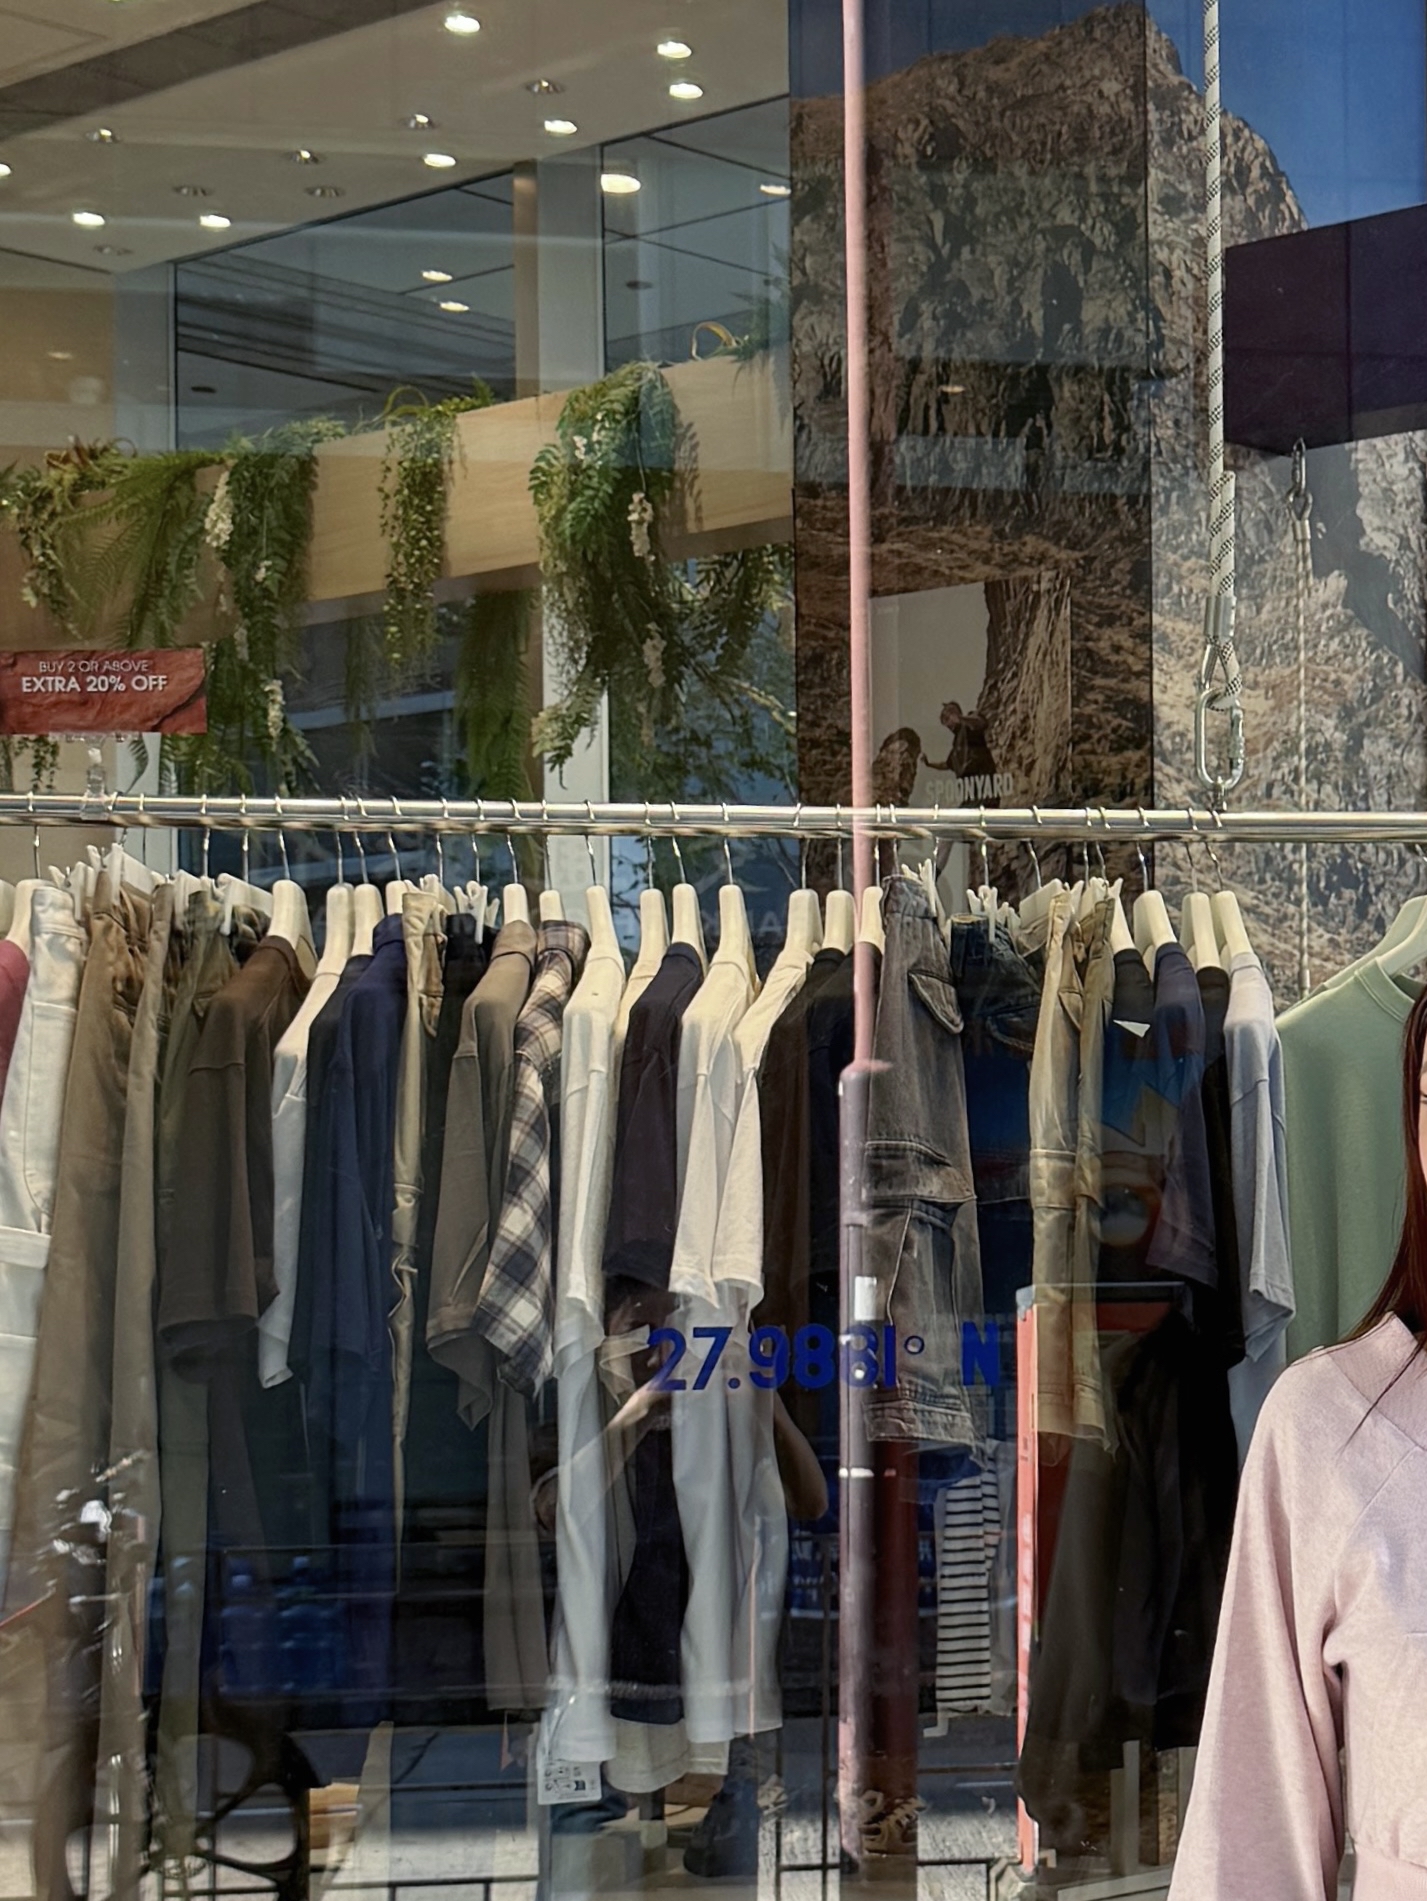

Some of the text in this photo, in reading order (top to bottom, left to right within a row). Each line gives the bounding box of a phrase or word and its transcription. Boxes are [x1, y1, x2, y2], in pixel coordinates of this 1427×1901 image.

[39, 660, 149, 672] BUY 2 OR ABOVE
[22, 675, 167, 692] EXTRA 20% OFF
[925, 772, 1014, 801] SPOONYARD
[961, 1320, 999, 1387] N
